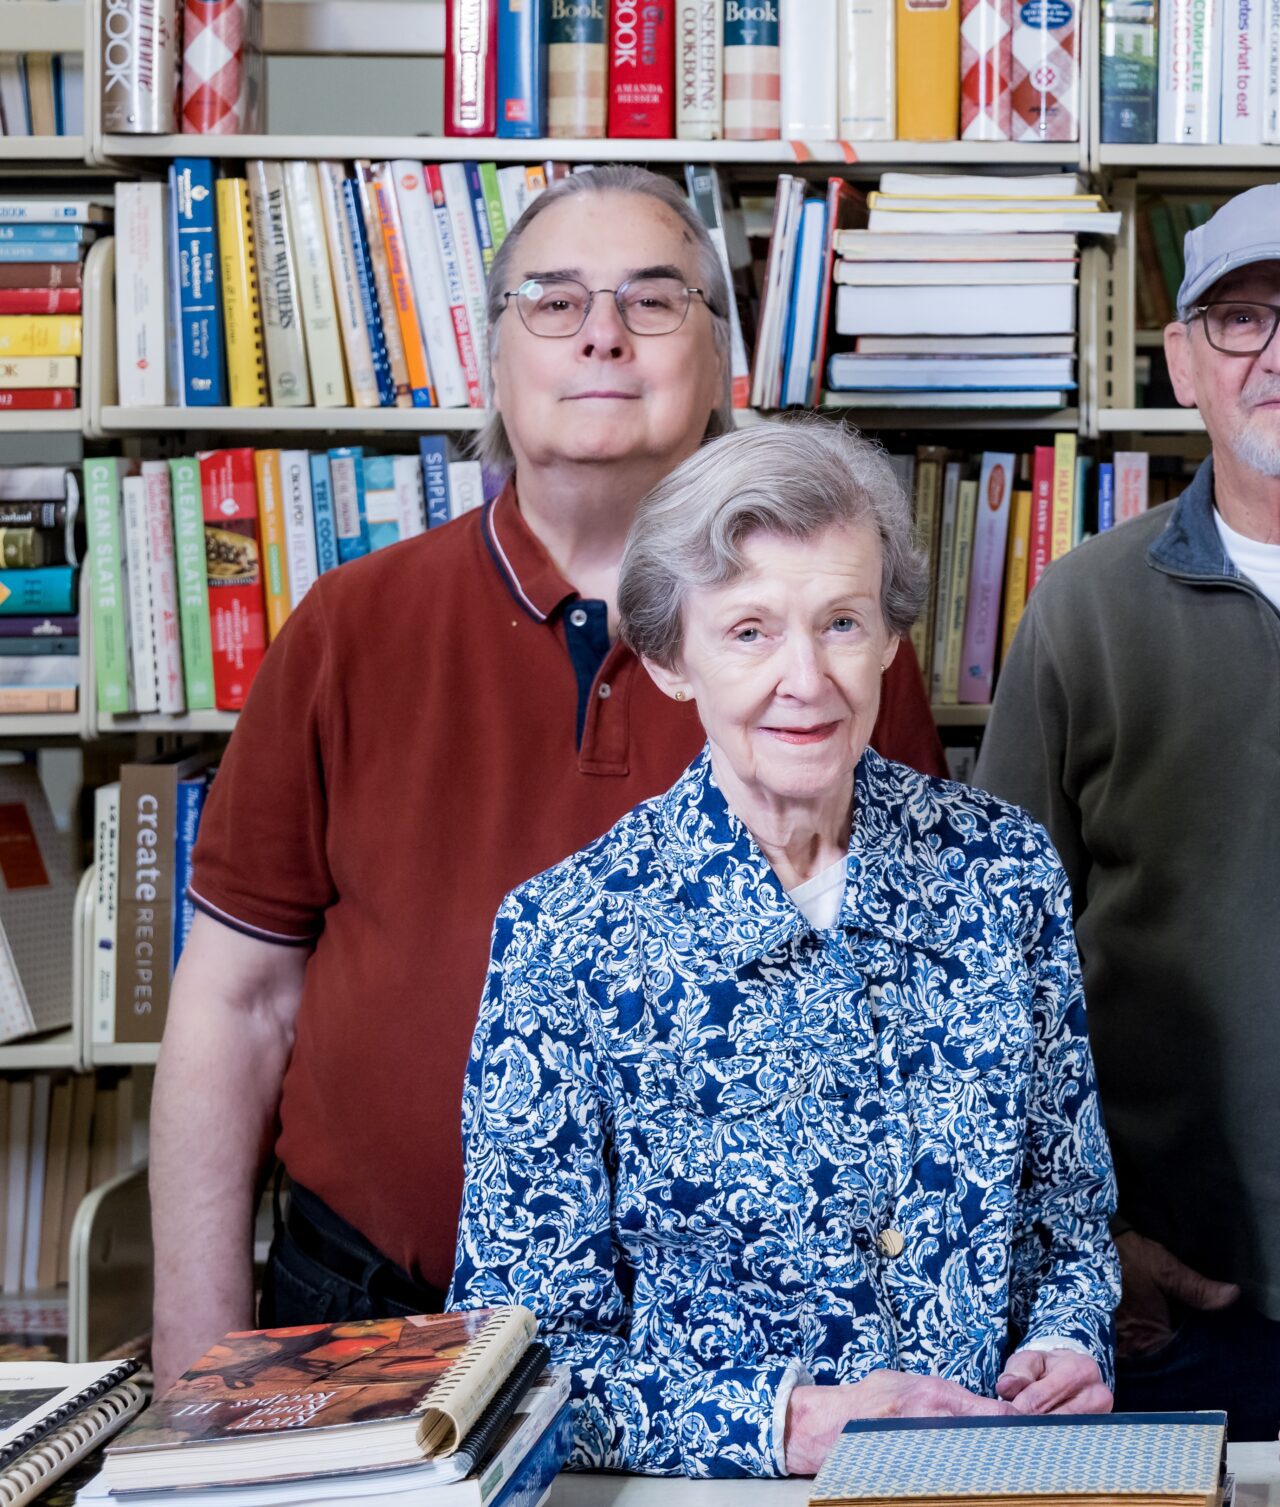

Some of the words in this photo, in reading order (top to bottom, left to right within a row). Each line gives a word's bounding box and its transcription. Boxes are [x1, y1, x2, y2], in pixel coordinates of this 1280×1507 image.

[725, 1, 778, 22] Book
[681, 8, 697, 110] COOKBOOK
[1237, 33, 1252, 71] what
[616, 85, 663, 93] AMANDA
[1238, 75, 1251, 90] to
[617, 95, 660, 104] HESSER
[1236, 93, 1250, 118] eat
[268, 189, 286, 247] WEIGHT
[224, 255, 235, 282] Lean
[388, 235, 403, 275] Eating
[436, 212, 453, 257] SKINNY
[446, 260, 463, 303] MEALS
[225, 285, 236, 297] &
[275, 250, 295, 331] WATCHERS
[226, 298, 238, 345] Luscious
[455, 308, 470, 334] BOB
[92, 466, 113, 539] CLEAN
[178, 466, 199, 537] CLEAN
[316, 479, 330, 512] THE
[425, 452, 448, 522] SIMPLY
[1058, 469, 1069, 505] HALF
[1039, 499, 1049, 532] DAYS
[1056, 509, 1068, 532] THE
[96, 545, 116, 609] SLATE
[183, 542, 203, 608] SLATE
[186, 788, 199, 807] The
[184, 809, 199, 842] Happy
[135, 794, 161, 902] create
[134, 907, 154, 1016] RECIPES
[169, 1401, 223, 1417] III
[229, 1391, 338, 1409] Recipes
[243, 1402, 329, 1422] Road
[223, 1413, 318, 1431] River
